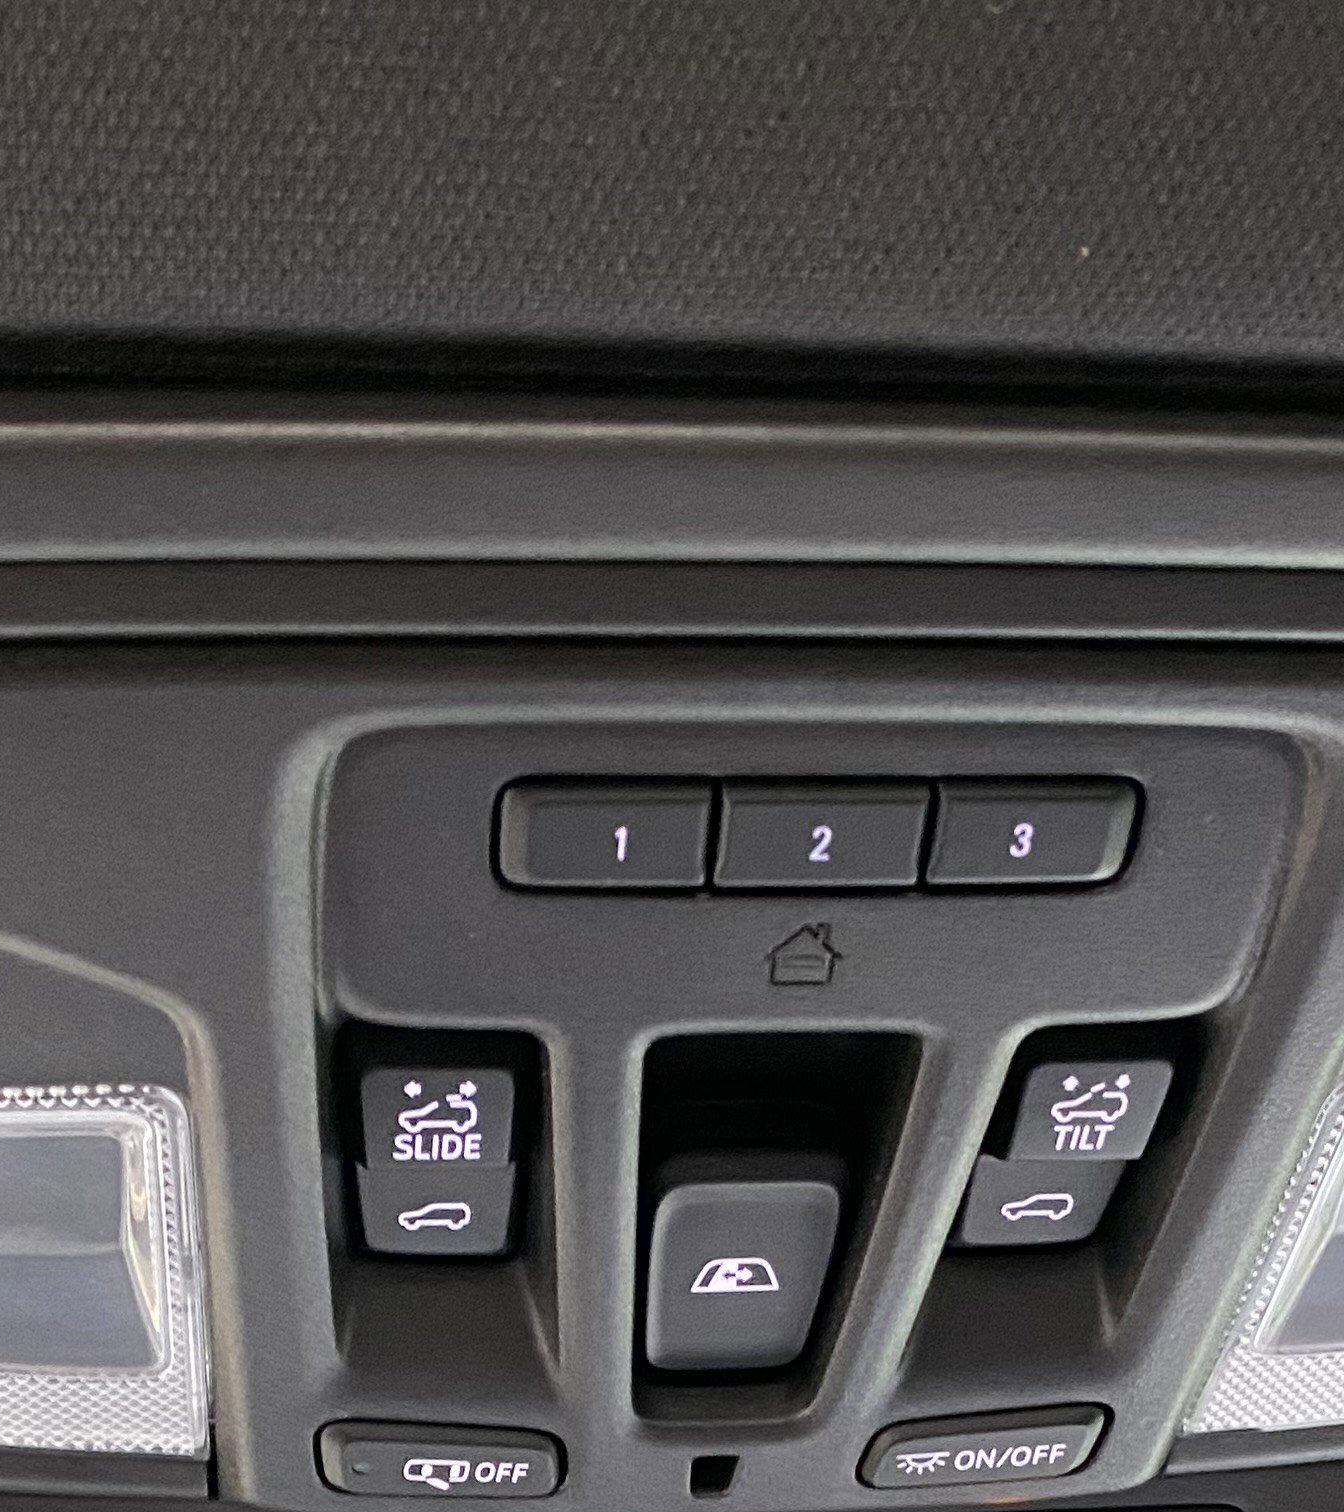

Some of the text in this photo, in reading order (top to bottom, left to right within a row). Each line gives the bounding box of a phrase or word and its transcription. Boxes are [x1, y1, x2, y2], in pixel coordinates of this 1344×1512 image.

[614, 825, 628, 862] 1
[809, 825, 833, 861] 2
[1009, 822, 1034, 858] 3
[392, 1133, 483, 1161] SLIDE
[1053, 1124, 1116, 1151] TILT
[954, 1443, 1066, 1471] ON/OFF
[474, 1461, 530, 1484] OFF
